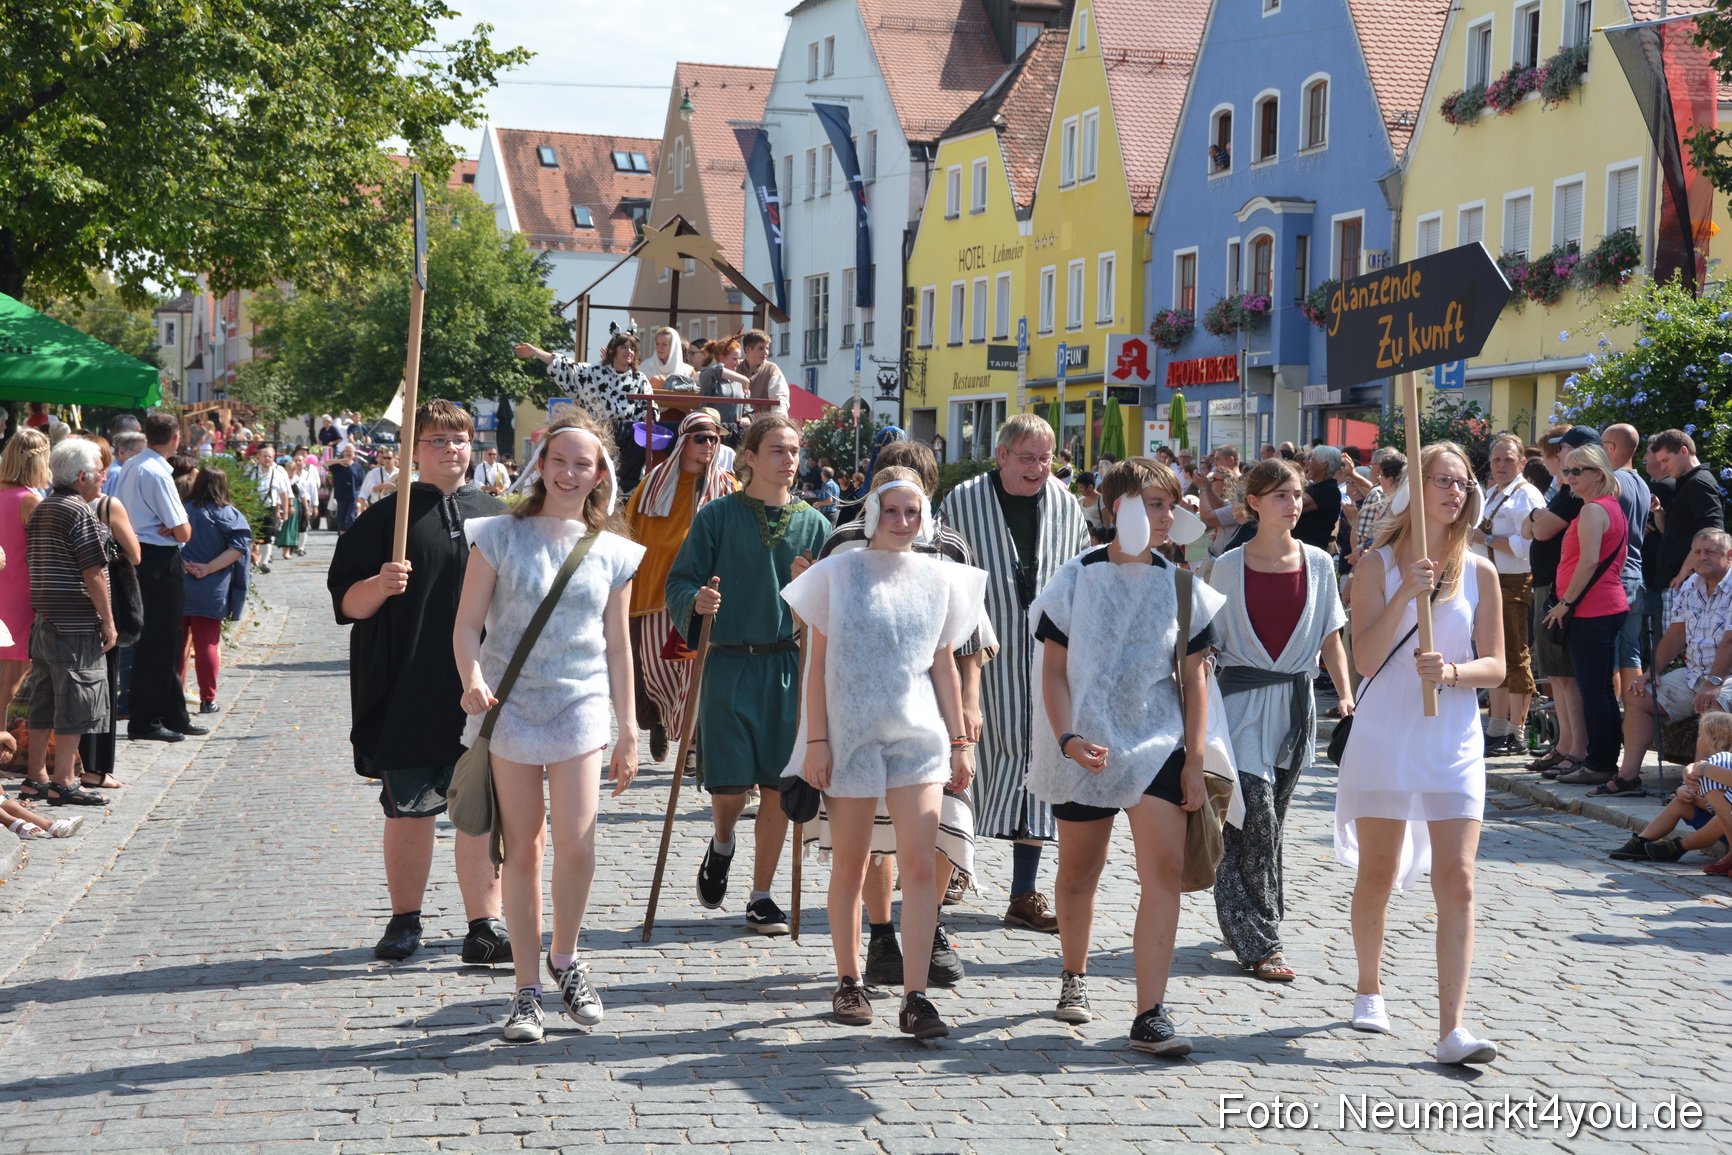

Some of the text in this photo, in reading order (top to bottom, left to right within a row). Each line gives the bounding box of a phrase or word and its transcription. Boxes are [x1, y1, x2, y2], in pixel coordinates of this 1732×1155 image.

[959, 241, 1024, 272] HOTEL Lehmeier
[1064, 349, 1082, 365] FUN
[952, 371, 991, 390] Restaurant
[1164, 355, 1238, 387] APOTHEKE
